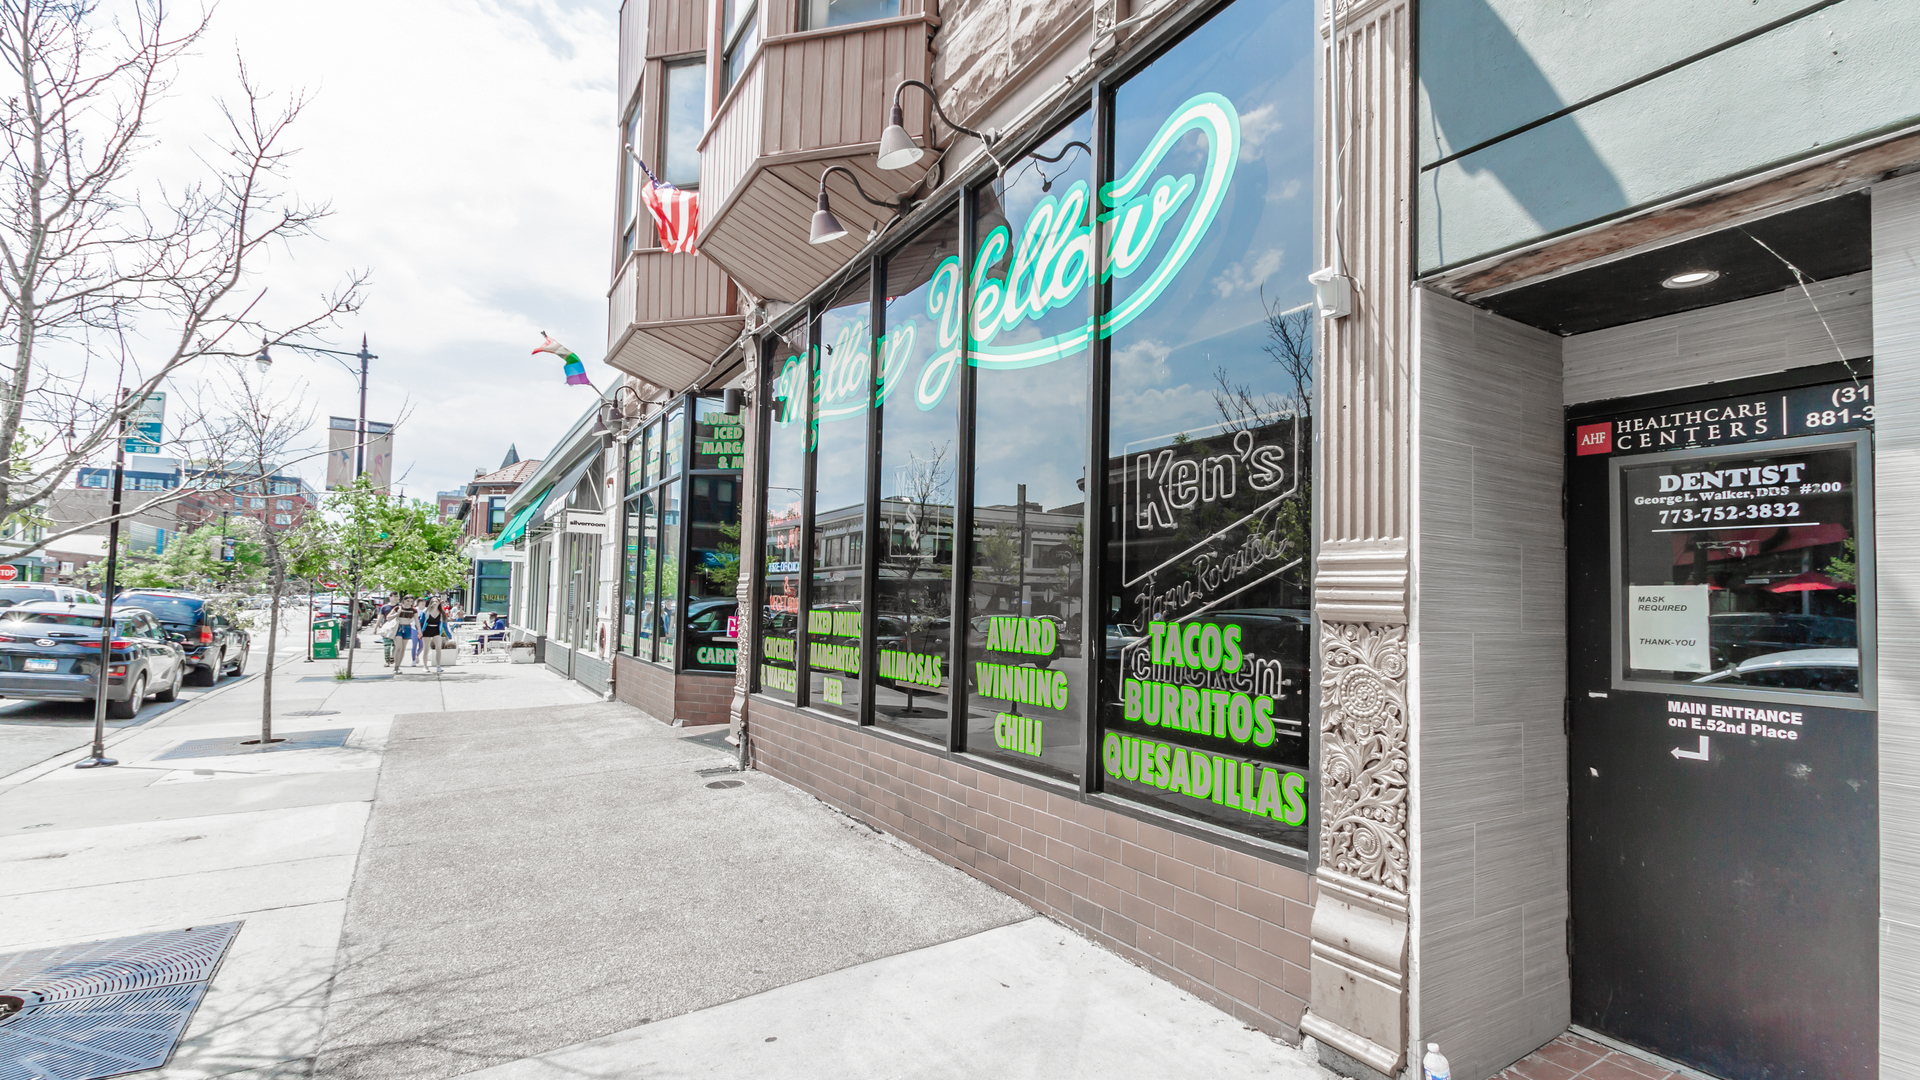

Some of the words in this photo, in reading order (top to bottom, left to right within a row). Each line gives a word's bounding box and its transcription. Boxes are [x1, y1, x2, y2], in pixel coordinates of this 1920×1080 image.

[779, 314, 918, 455] Mellow
[914, 93, 1241, 411] Yellow
[703, 412, 739, 426] LONG
[713, 426, 743, 440] ICED
[1616, 401, 1768, 435] HEALTHCARE
[1580, 431, 1606, 447] AHF
[1616, 418, 1769, 450] CENTERS
[718, 456, 729, 469] &
[1658, 462, 1806, 493] DENTIST
[1136, 430, 1285, 530] Ken's
[1633, 495, 1683, 506] George
[1684, 493, 1698, 503] L.
[1699, 486, 1755, 502] Walker,
[1755, 485, 1790, 498] DDS
[1799, 481, 1843, 495] #200
[1658, 501, 1801, 525] 773-752-3832
[1191, 516, 1288, 592] Roasted
[0, 569, 16, 577] TOP
[808, 610, 832, 635] MIXED
[1637, 604, 1688, 612] REQUIRED
[764, 636, 794, 662] CHICKEN
[986, 617, 1056, 656] AWARD
[1149, 621, 1243, 674] TACOS
[1639, 638, 1697, 647] THANK-YOU
[810, 642, 860, 675] MARGARITAS
[879, 649, 942, 688] MIMOSAS
[760, 664, 767, 685] &
[767, 665, 797, 694] WAFFLES
[823, 677, 843, 705] BEER
[976, 662, 1068, 711] WINNING
[1124, 678, 1276, 747] BURRITOS
[1667, 701, 1707, 716] MAIN
[1711, 704, 1804, 726] ENTRANCE
[994, 712, 1043, 757] CHILI
[1668, 717, 1687, 729] on
[1691, 717, 1747, 735] E.52nd
[1750, 723, 1799, 741] Place
[1103, 732, 1307, 826] QUESADILLAS
